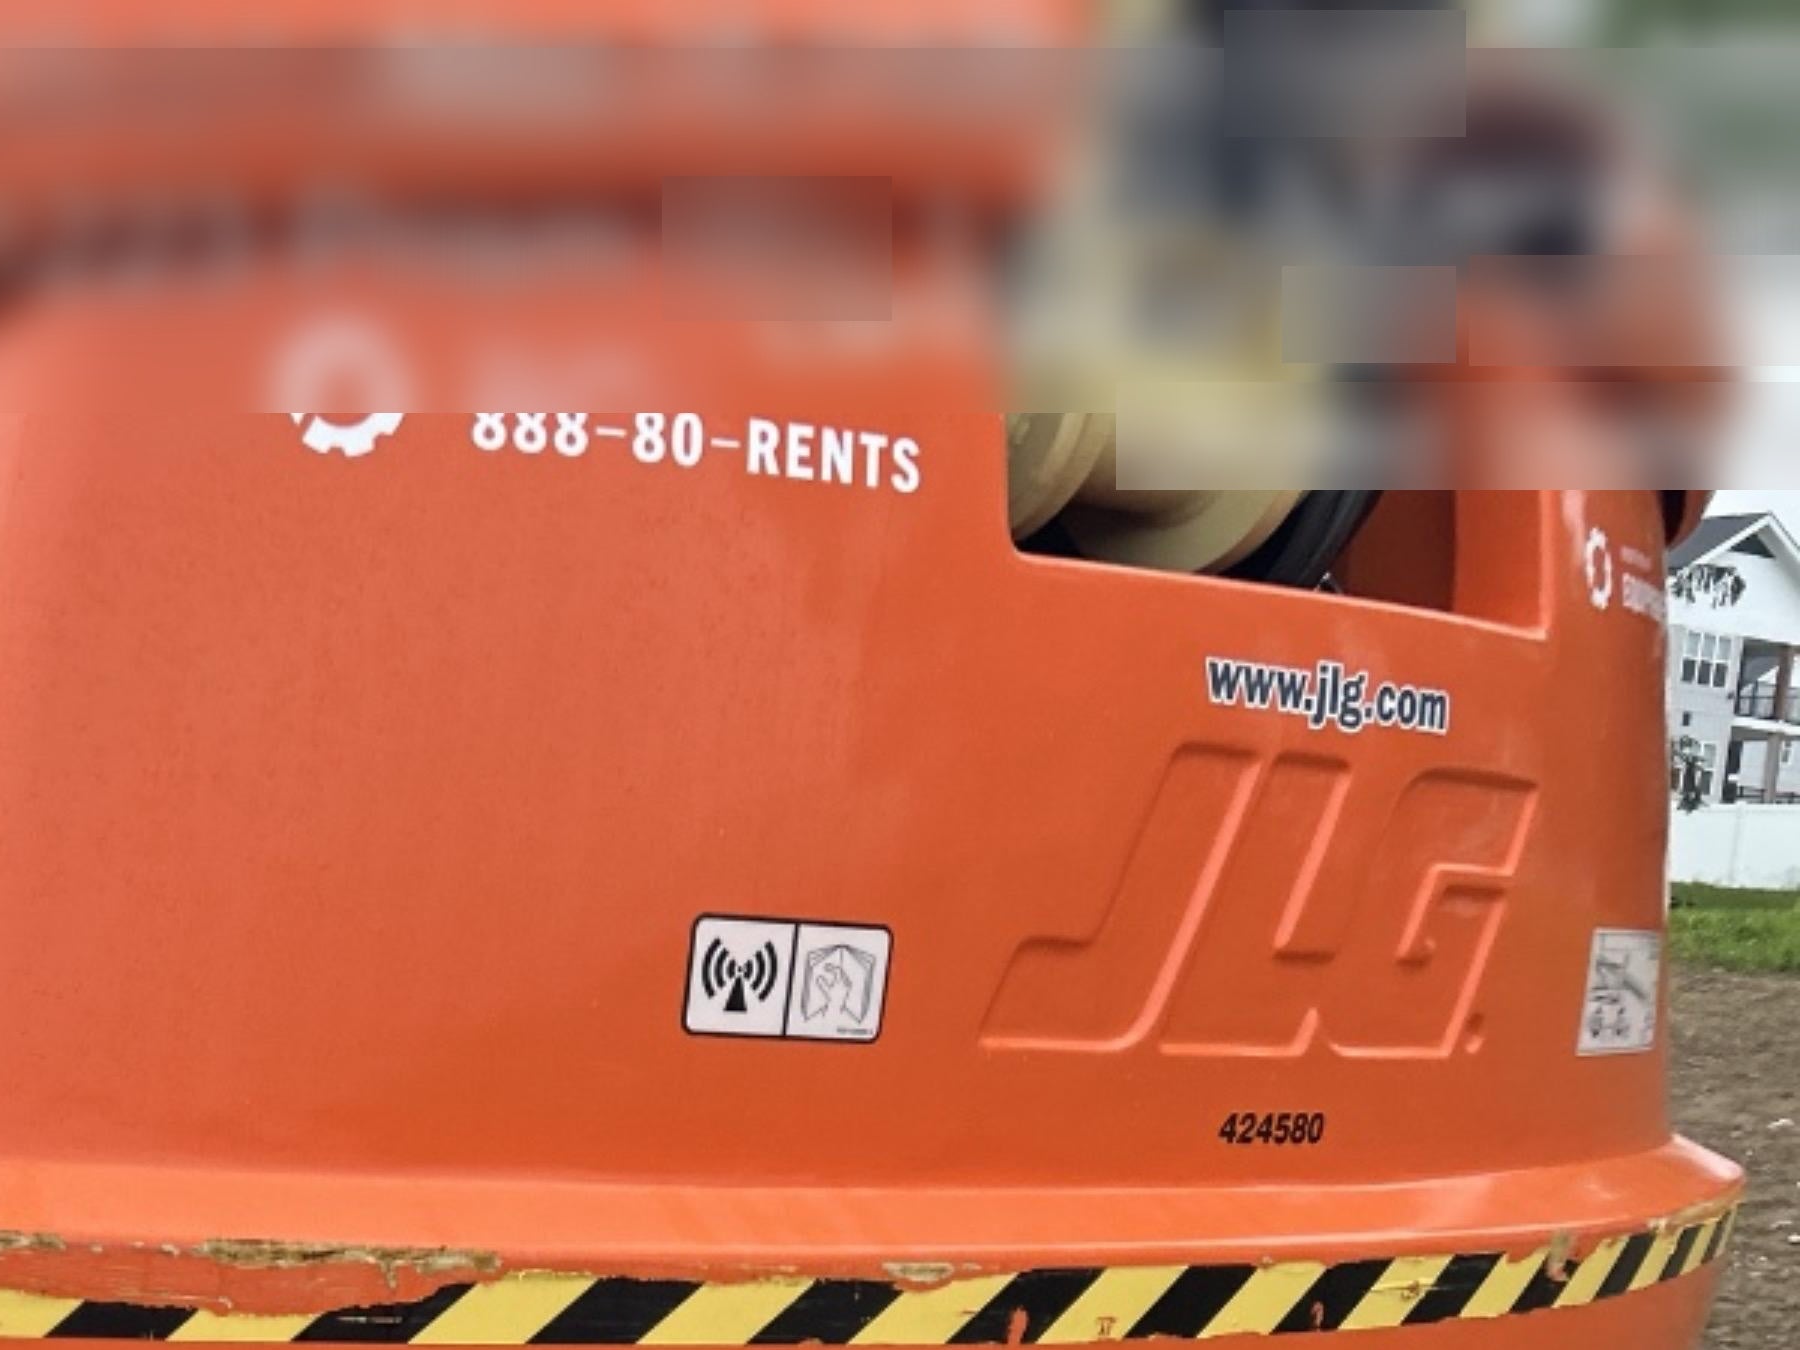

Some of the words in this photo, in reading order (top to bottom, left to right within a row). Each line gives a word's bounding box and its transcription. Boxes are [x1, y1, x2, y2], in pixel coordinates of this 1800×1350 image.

[1206, 657, 1449, 735] www.jlg.com
[977, 741, 1539, 1057] JLG
[1218, 1112, 1326, 1145] 424580
